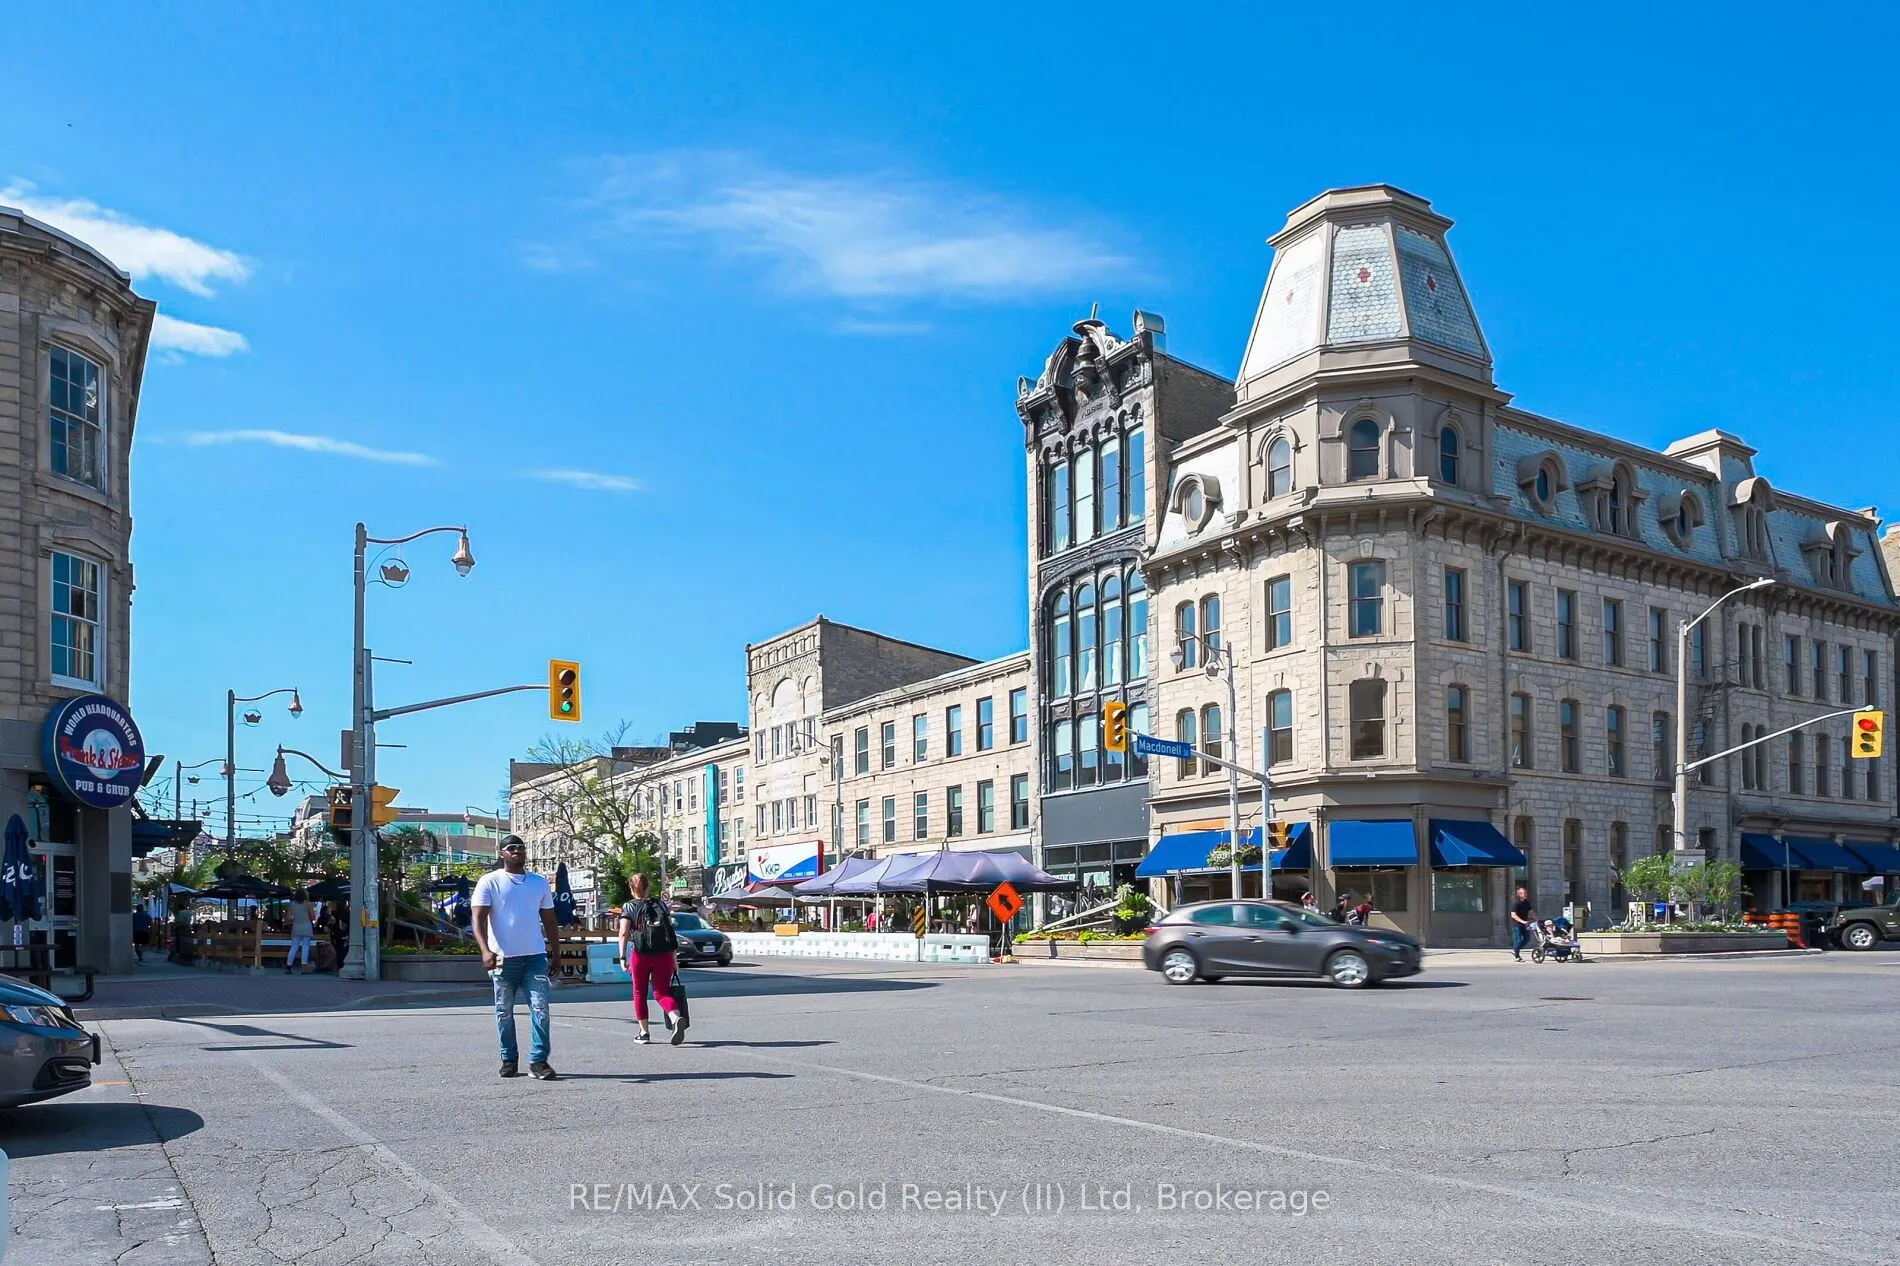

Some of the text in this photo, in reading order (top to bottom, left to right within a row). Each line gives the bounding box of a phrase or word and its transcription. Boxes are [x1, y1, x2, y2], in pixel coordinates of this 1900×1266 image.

[64, 703, 137, 747] WORLD HEADQUARTERS
[1138, 739, 1182, 755] Macdonell
[75, 779, 130, 796] PUB & GRUB
[765, 863, 780, 875] KKP
